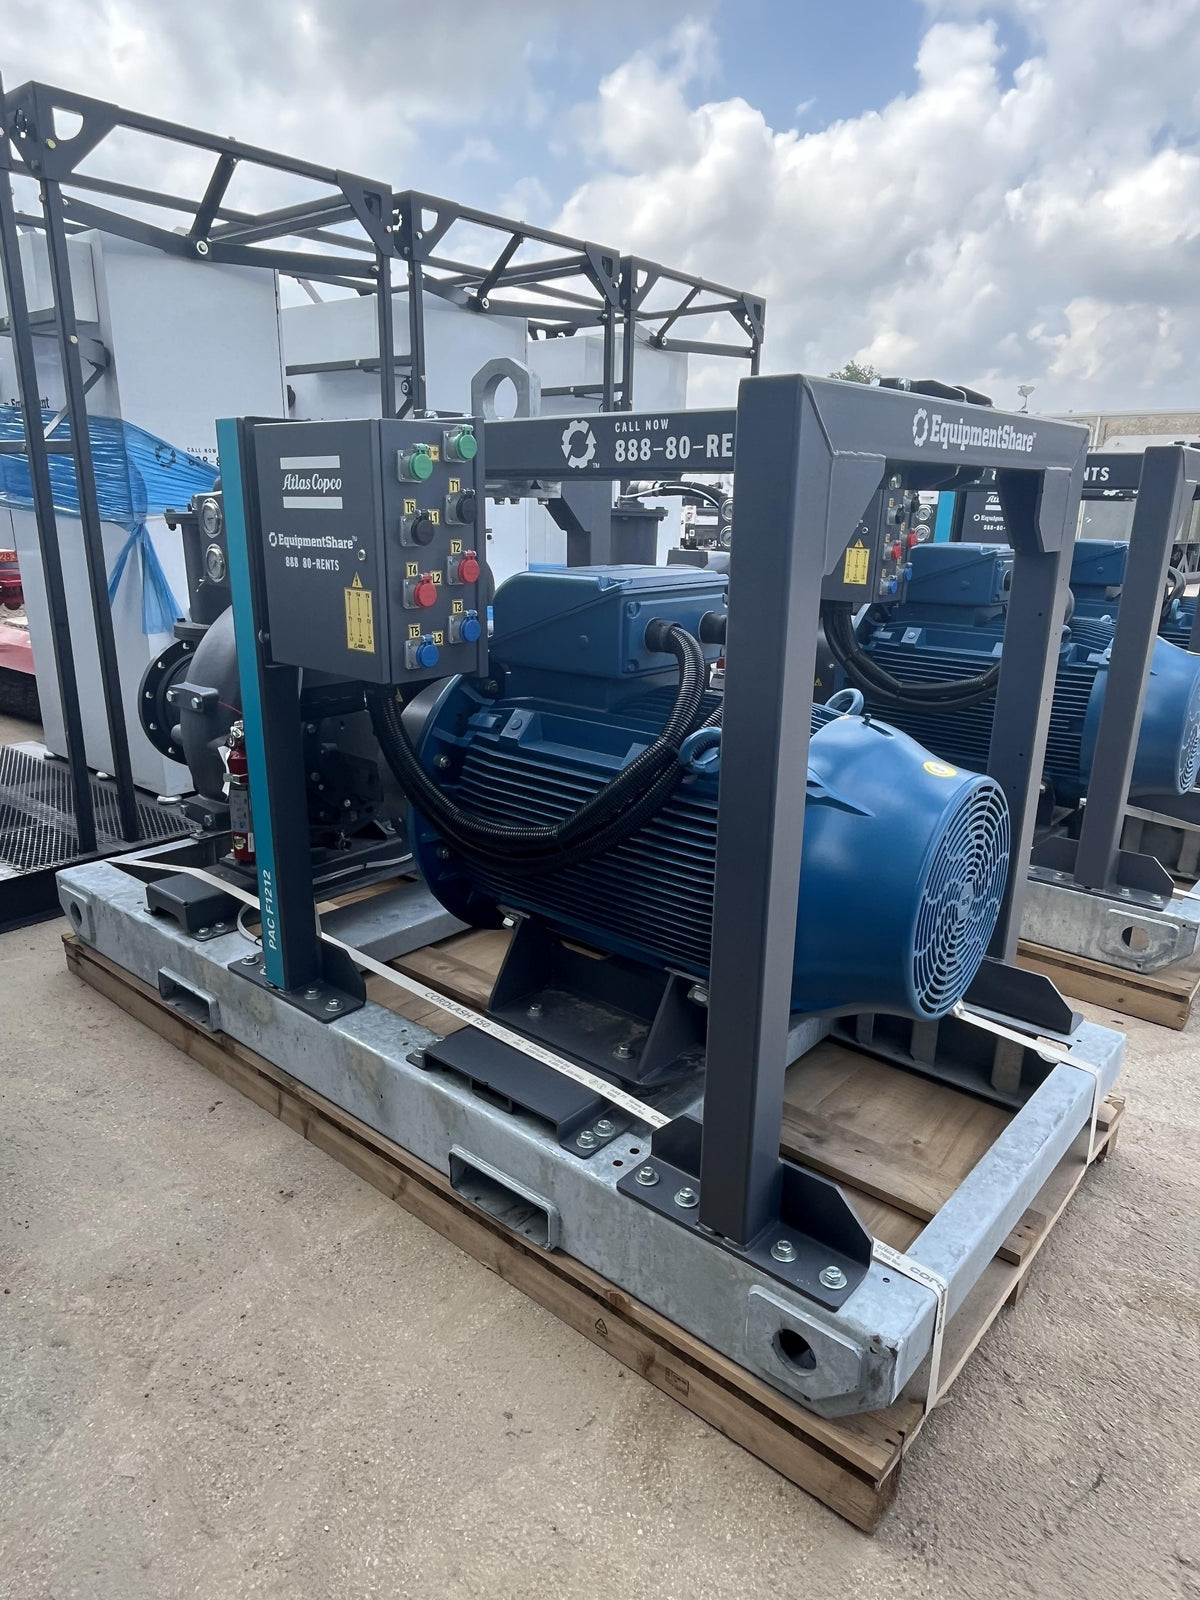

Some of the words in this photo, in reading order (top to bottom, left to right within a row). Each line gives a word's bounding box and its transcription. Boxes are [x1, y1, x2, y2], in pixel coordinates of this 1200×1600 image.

[615, 421, 640, 433] CALL
[645, 418, 669, 431] NOW
[615, 433, 734, 462] 888-80-RE
[1083, 466, 1110, 481] NTS
[282, 473, 311, 491] Atlas
[312, 473, 342, 494] Copco
[451, 480, 459, 491] T1
[406, 501, 415, 513] T6
[452, 542, 461, 553] T2
[408, 564, 417, 575] T4
[432, 573, 440, 584] L2
[453, 602, 462, 612] T3
[410, 626, 420, 637] T5
[434, 633, 442, 644] L3
[262, 869, 274, 915] F1212
[266, 917, 278, 950] PAC
[473, 1017, 491, 1028] 150
